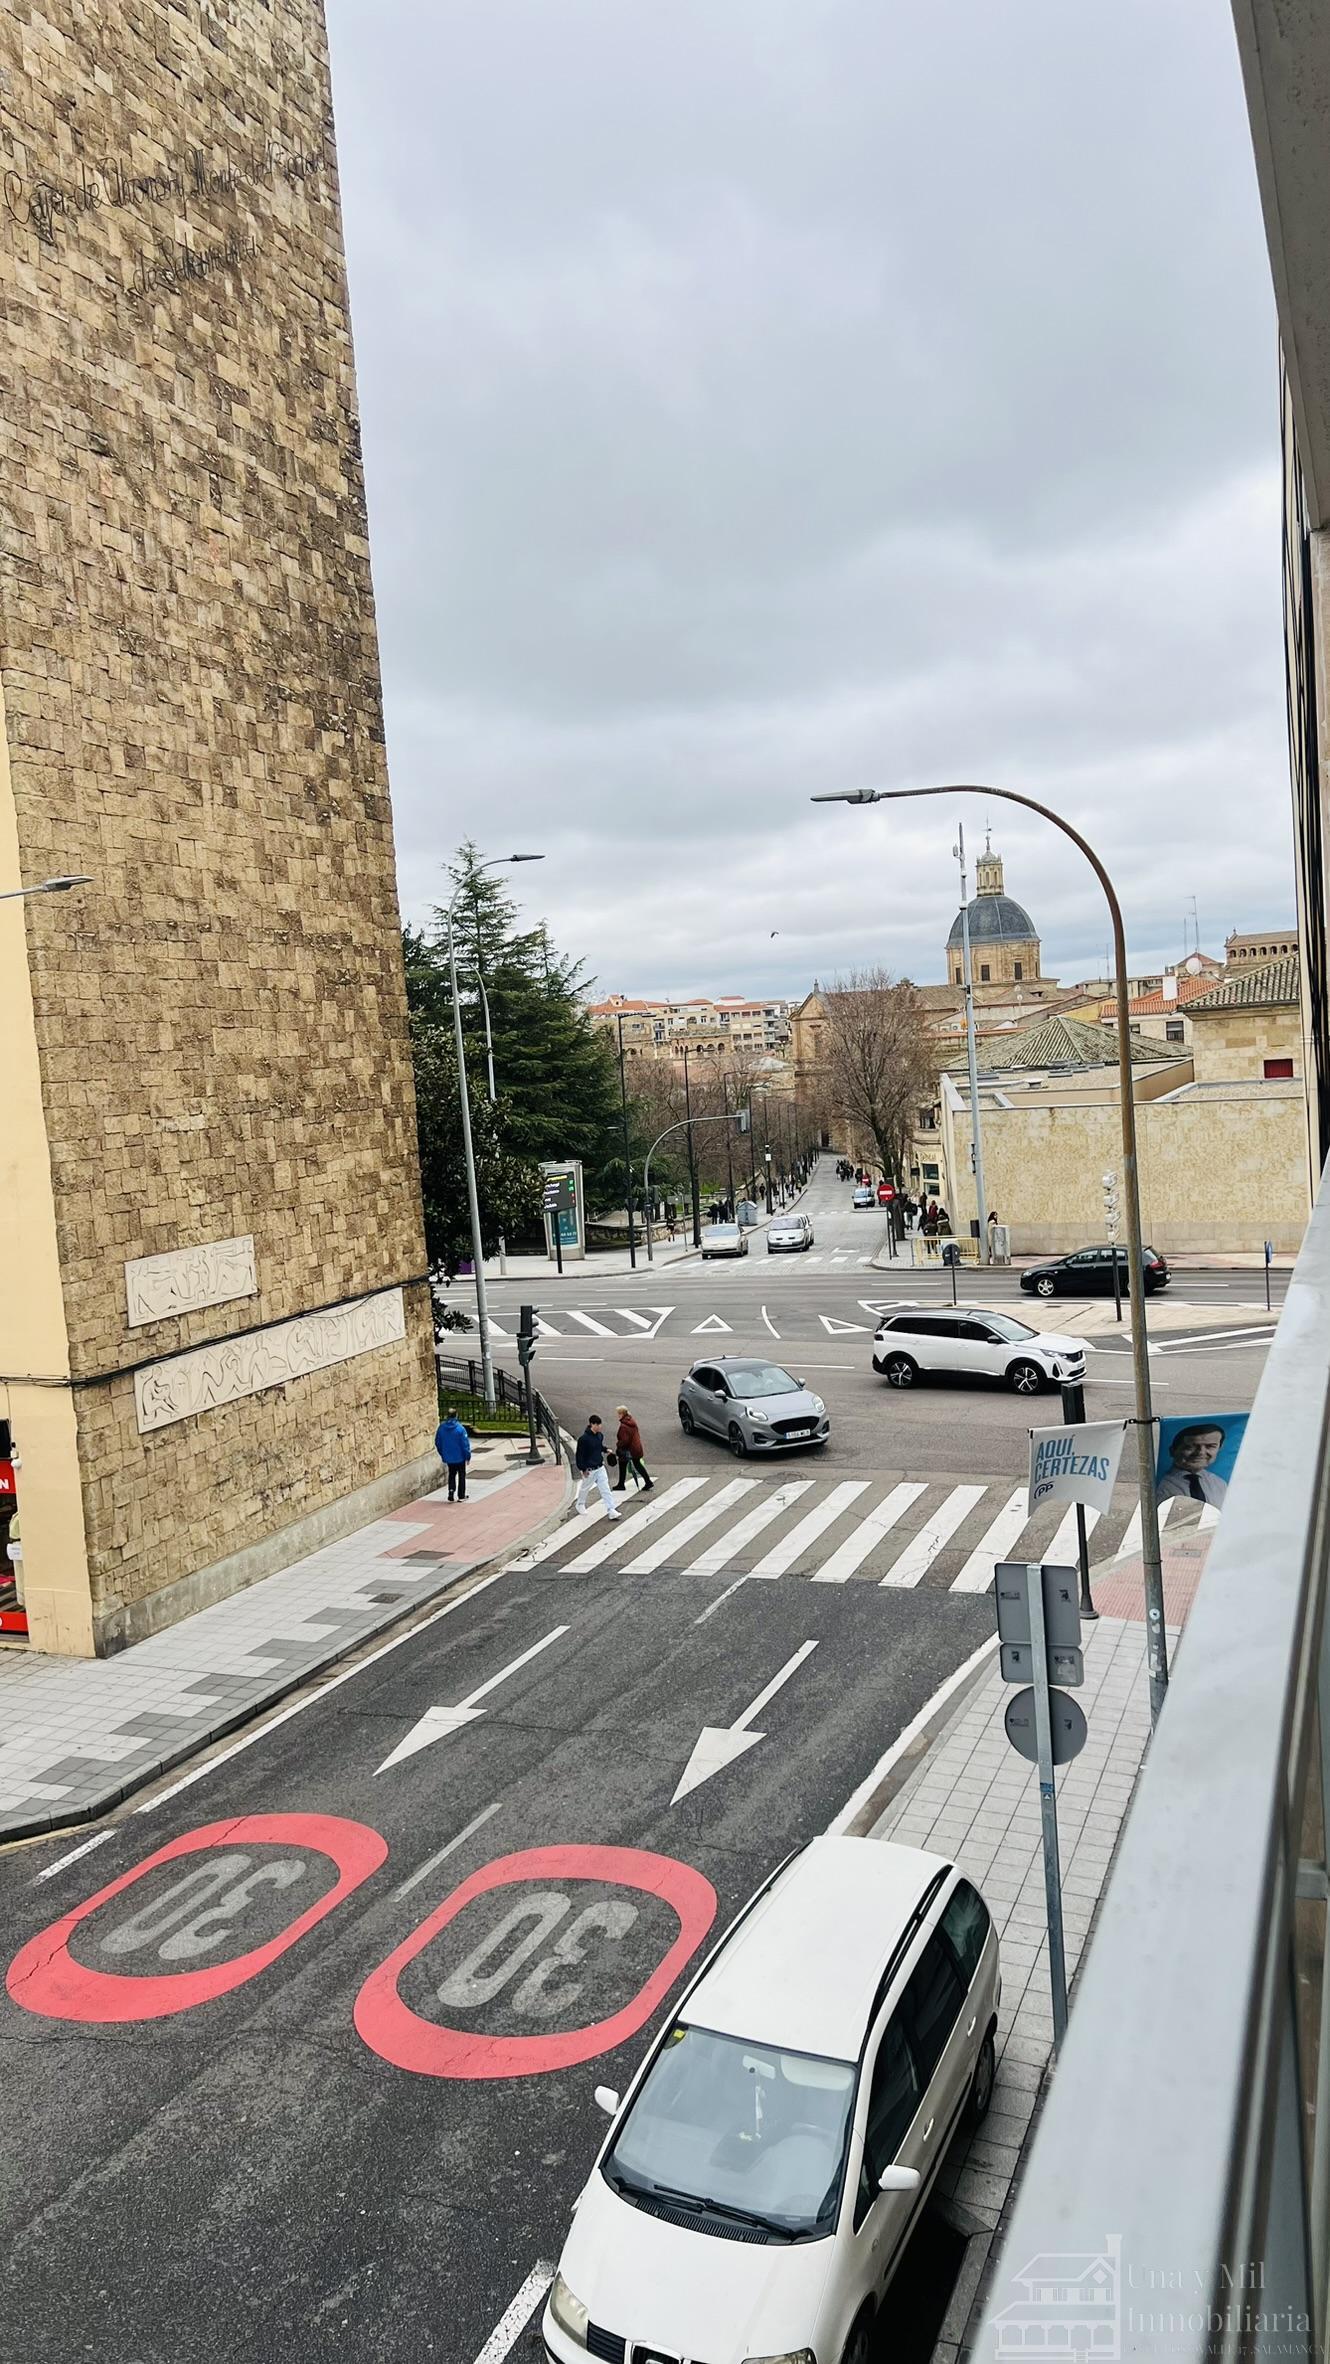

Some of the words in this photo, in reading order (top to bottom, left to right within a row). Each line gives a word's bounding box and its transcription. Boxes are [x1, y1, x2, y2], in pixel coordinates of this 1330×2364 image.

[1035, 1455, 1110, 1484] CERTEZAS
[100, 1854, 306, 1960] 30
[437, 1891, 639, 2018] 30
